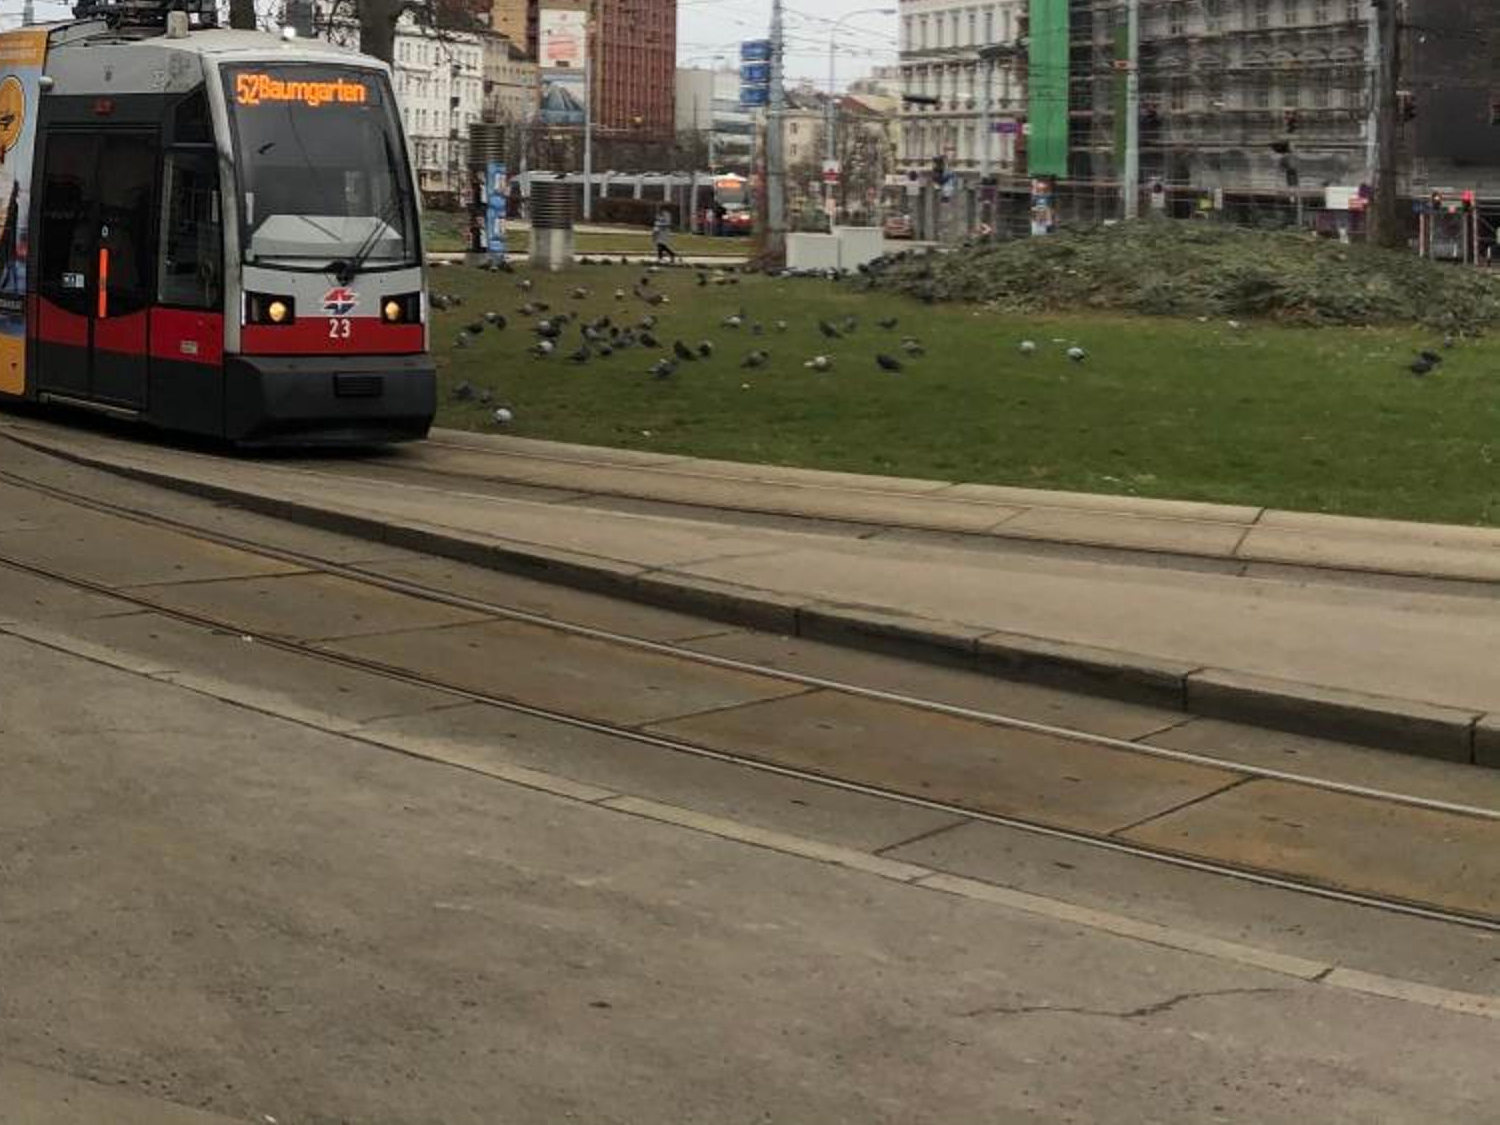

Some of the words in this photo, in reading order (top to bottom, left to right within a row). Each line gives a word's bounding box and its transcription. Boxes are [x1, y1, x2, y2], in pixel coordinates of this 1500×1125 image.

[236, 73, 260, 106] 52
[259, 74, 367, 106] Baumgarten
[329, 318, 351, 338] 23
